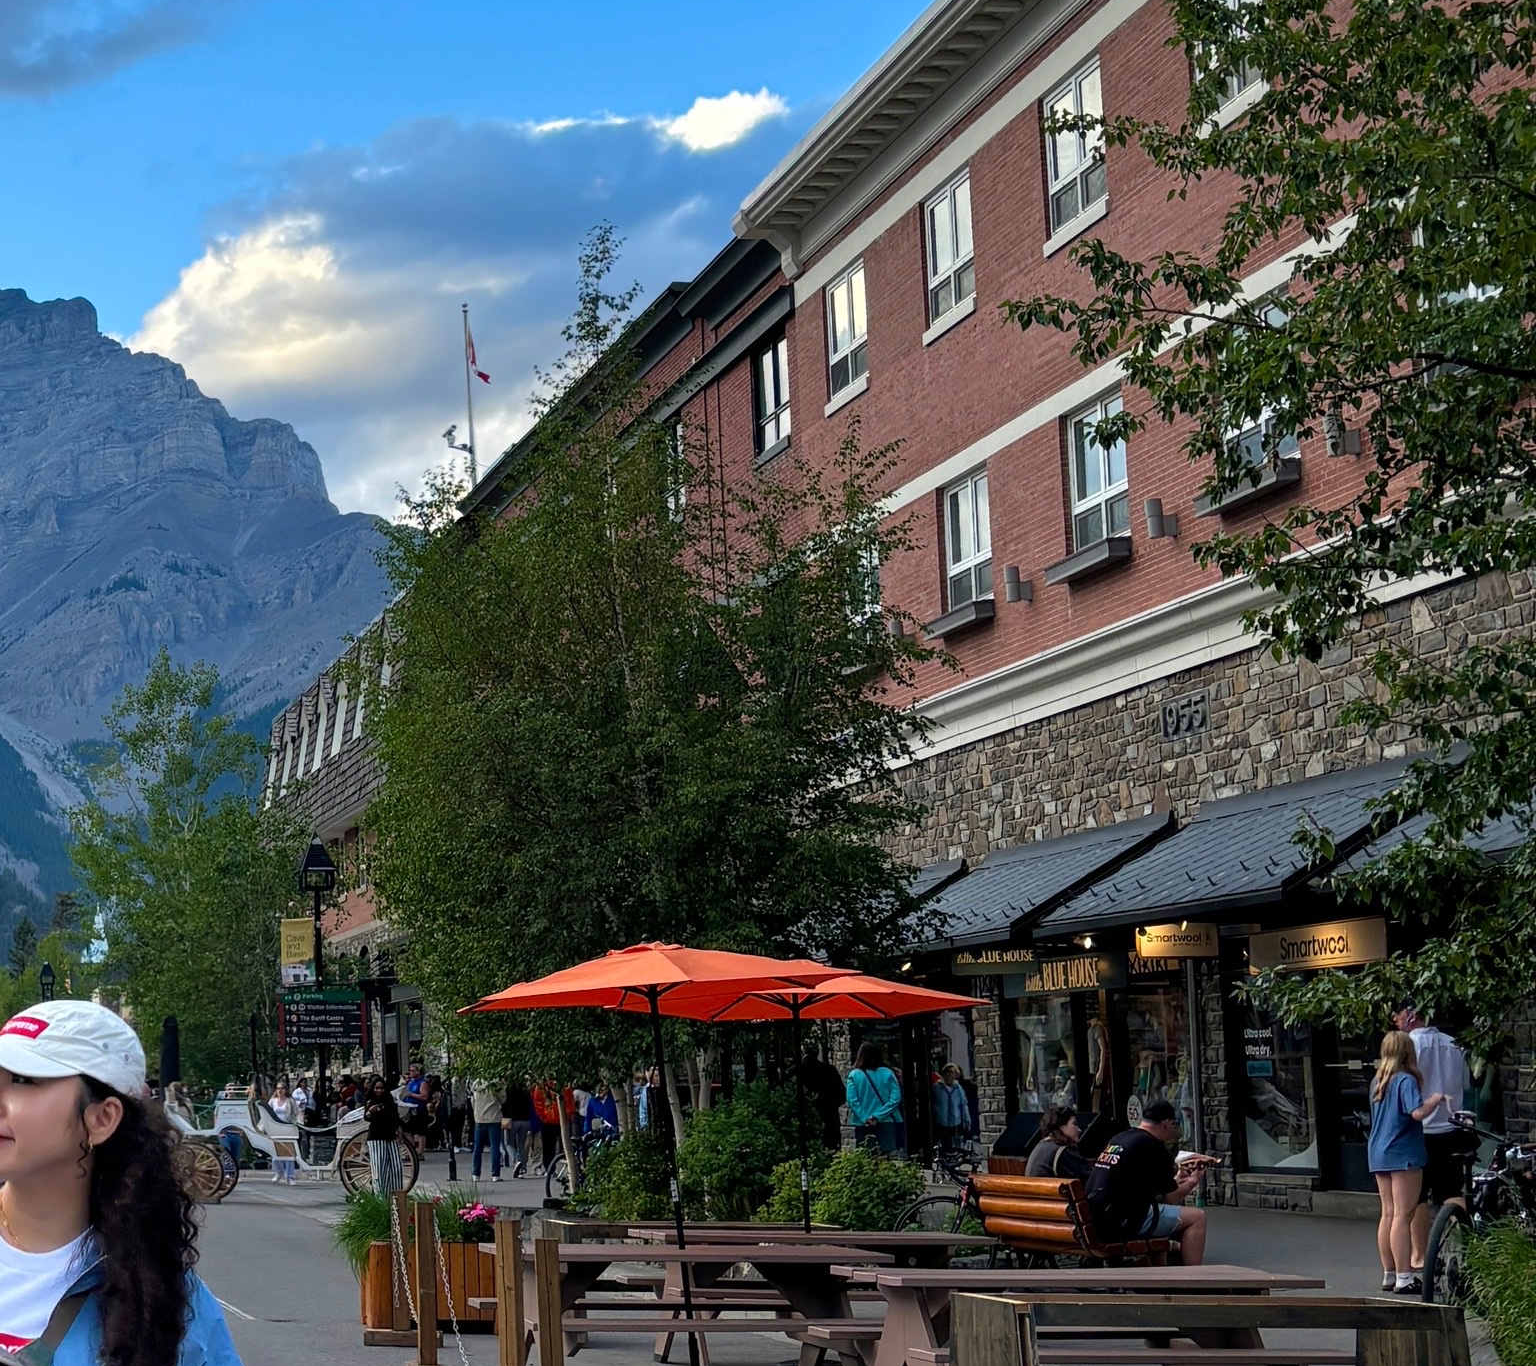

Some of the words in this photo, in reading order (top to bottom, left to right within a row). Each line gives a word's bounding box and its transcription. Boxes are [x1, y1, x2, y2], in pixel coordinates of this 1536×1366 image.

[1162, 694, 1206, 737] 1955
[285, 934, 305, 943] Cave
[1146, 932, 1202, 943] Smartwool
[1280, 927, 1349, 960] Smartwool
[286, 942, 301, 950] and
[286, 950, 308, 958] Basin
[1002, 949, 1035, 962] HOUSE
[1042, 961, 1067, 991] BLUE
[1067, 957, 1100, 988] HOUSE
